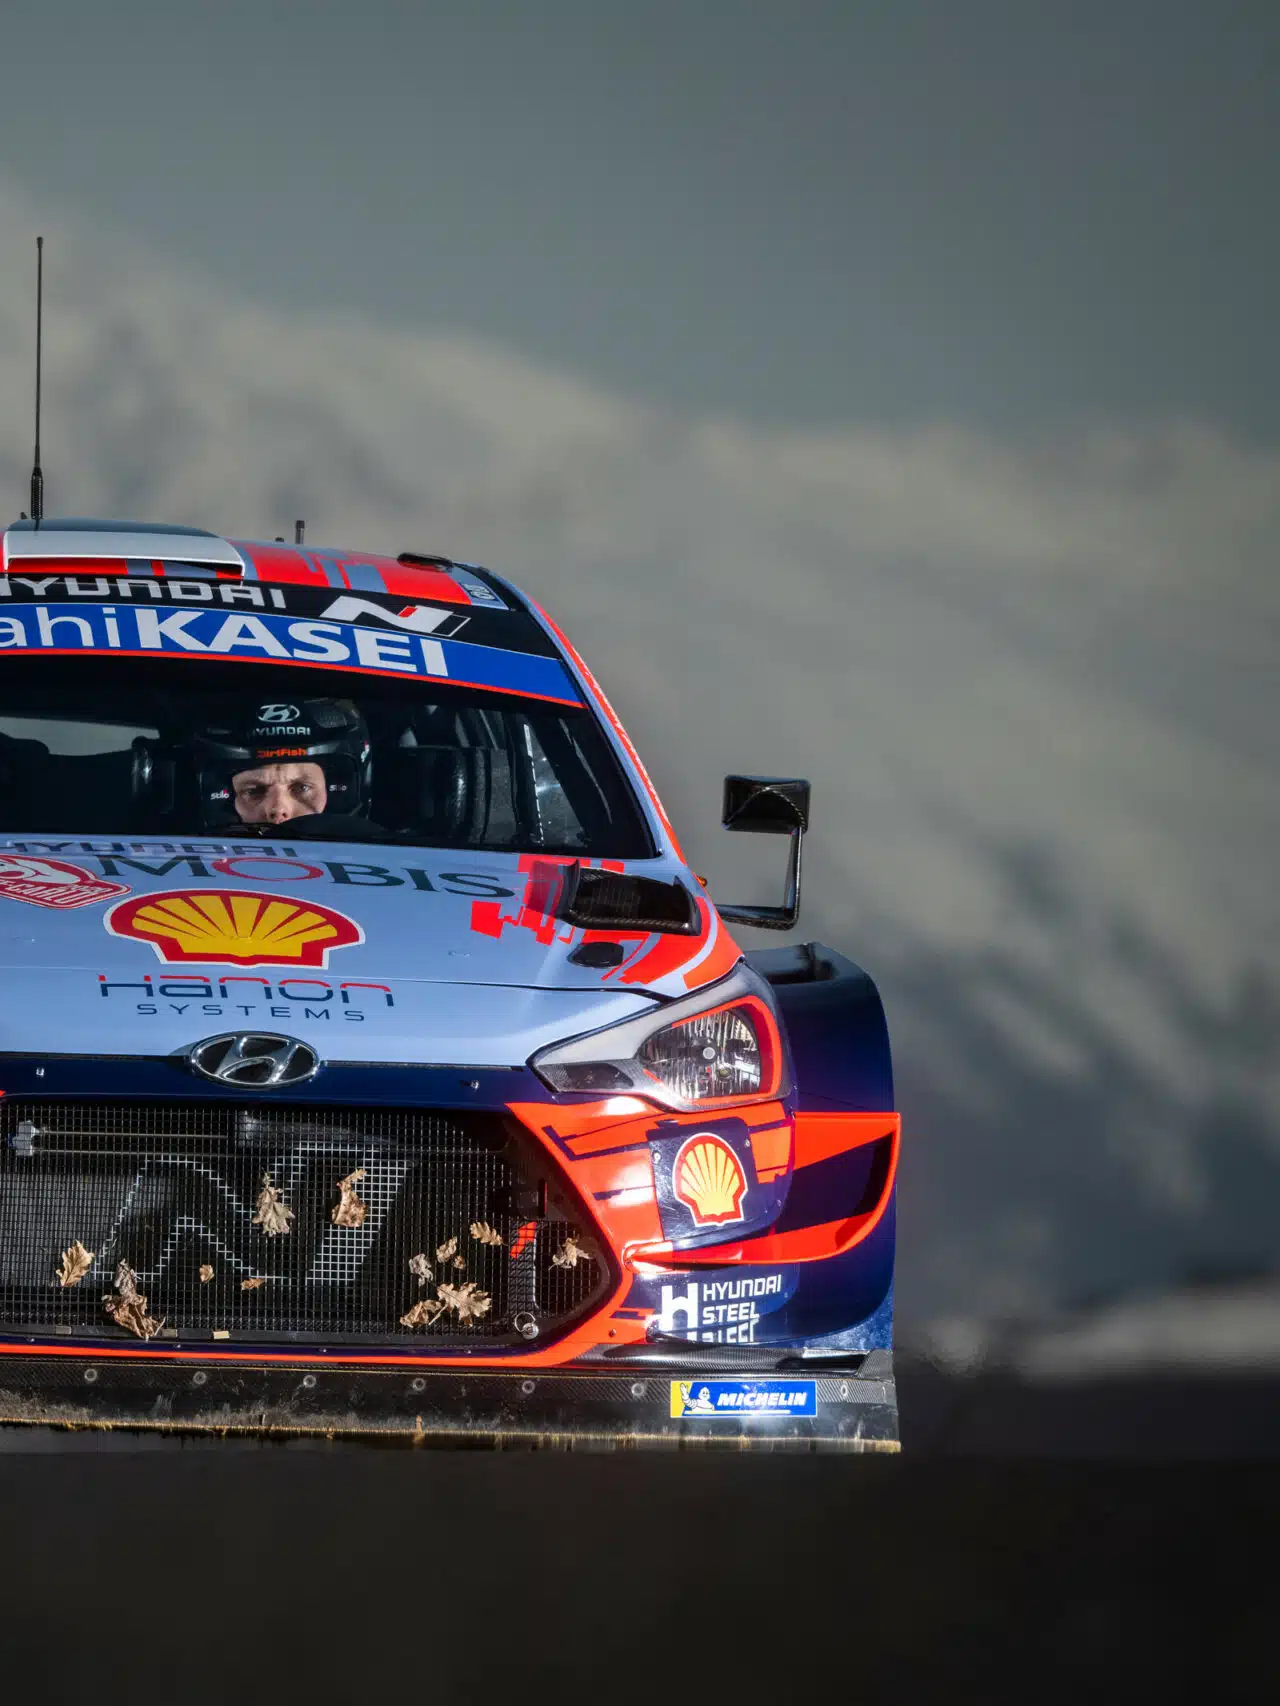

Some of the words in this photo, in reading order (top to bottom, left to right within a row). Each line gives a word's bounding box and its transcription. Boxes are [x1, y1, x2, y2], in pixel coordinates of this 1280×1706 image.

[93, 853, 519, 899] MOBIS
[136, 1003, 365, 1022] SYSTEMS
[702, 1274, 782, 1302] HYUNDAI
[701, 1301, 760, 1325] STEEL
[716, 1391, 808, 1407] MICHELIN
